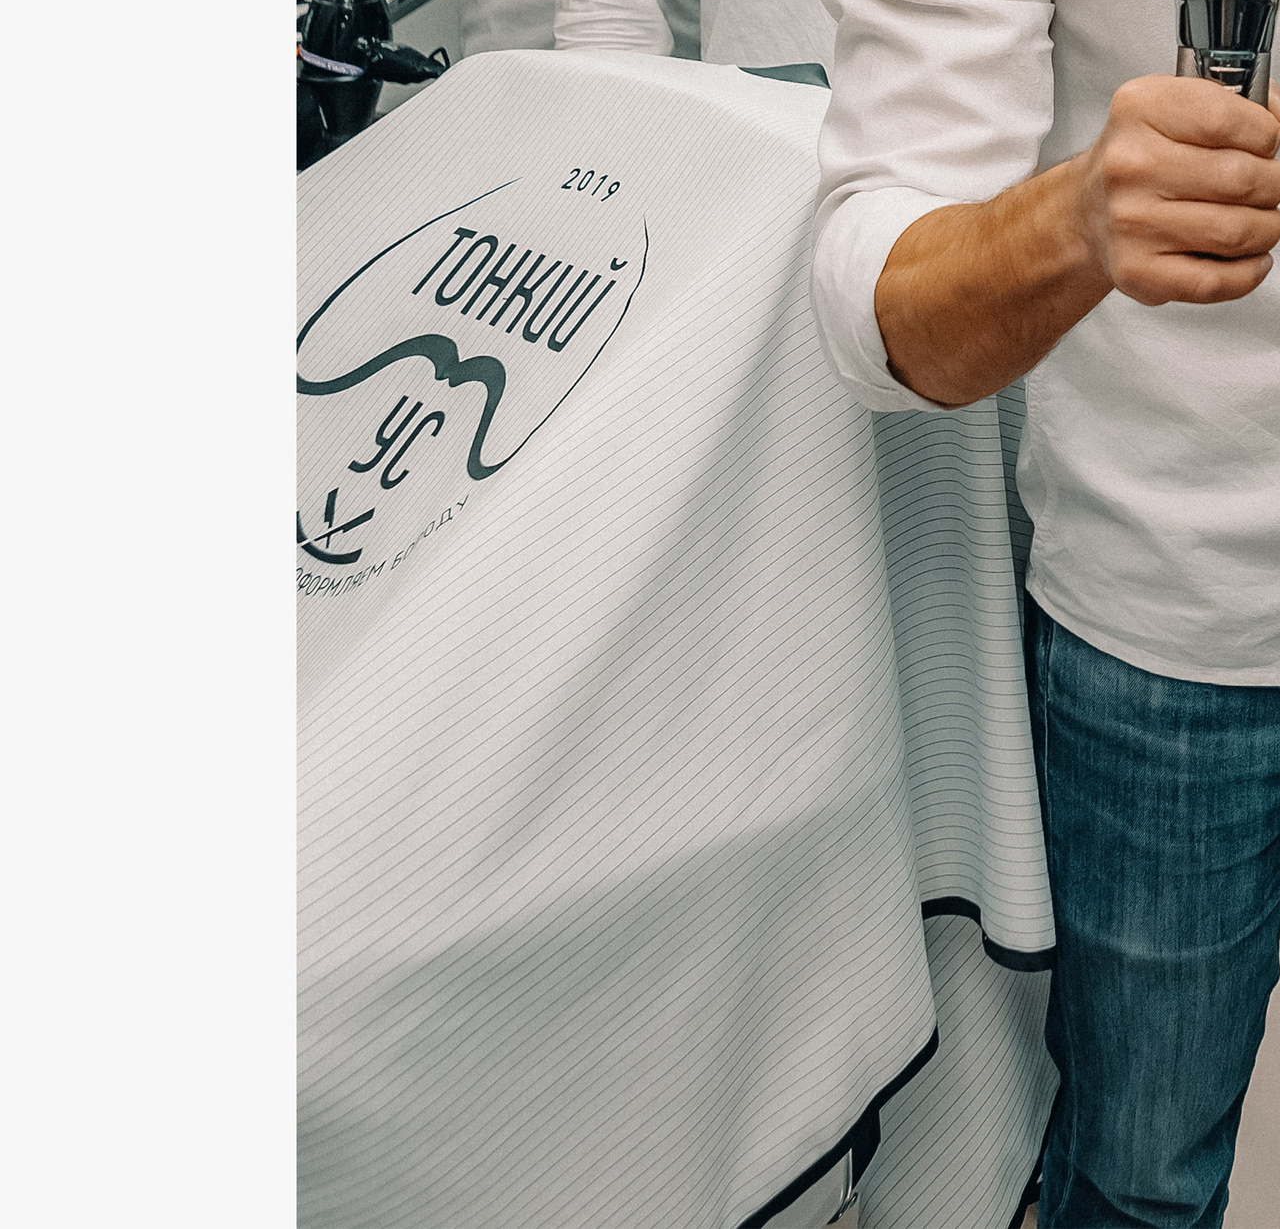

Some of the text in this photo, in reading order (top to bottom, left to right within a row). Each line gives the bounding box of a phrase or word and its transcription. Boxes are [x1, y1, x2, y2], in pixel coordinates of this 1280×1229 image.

[561, 167, 621, 202] 2019
[411, 226, 628, 353] ТОНКИЙ
[347, 395, 446, 489] УС
